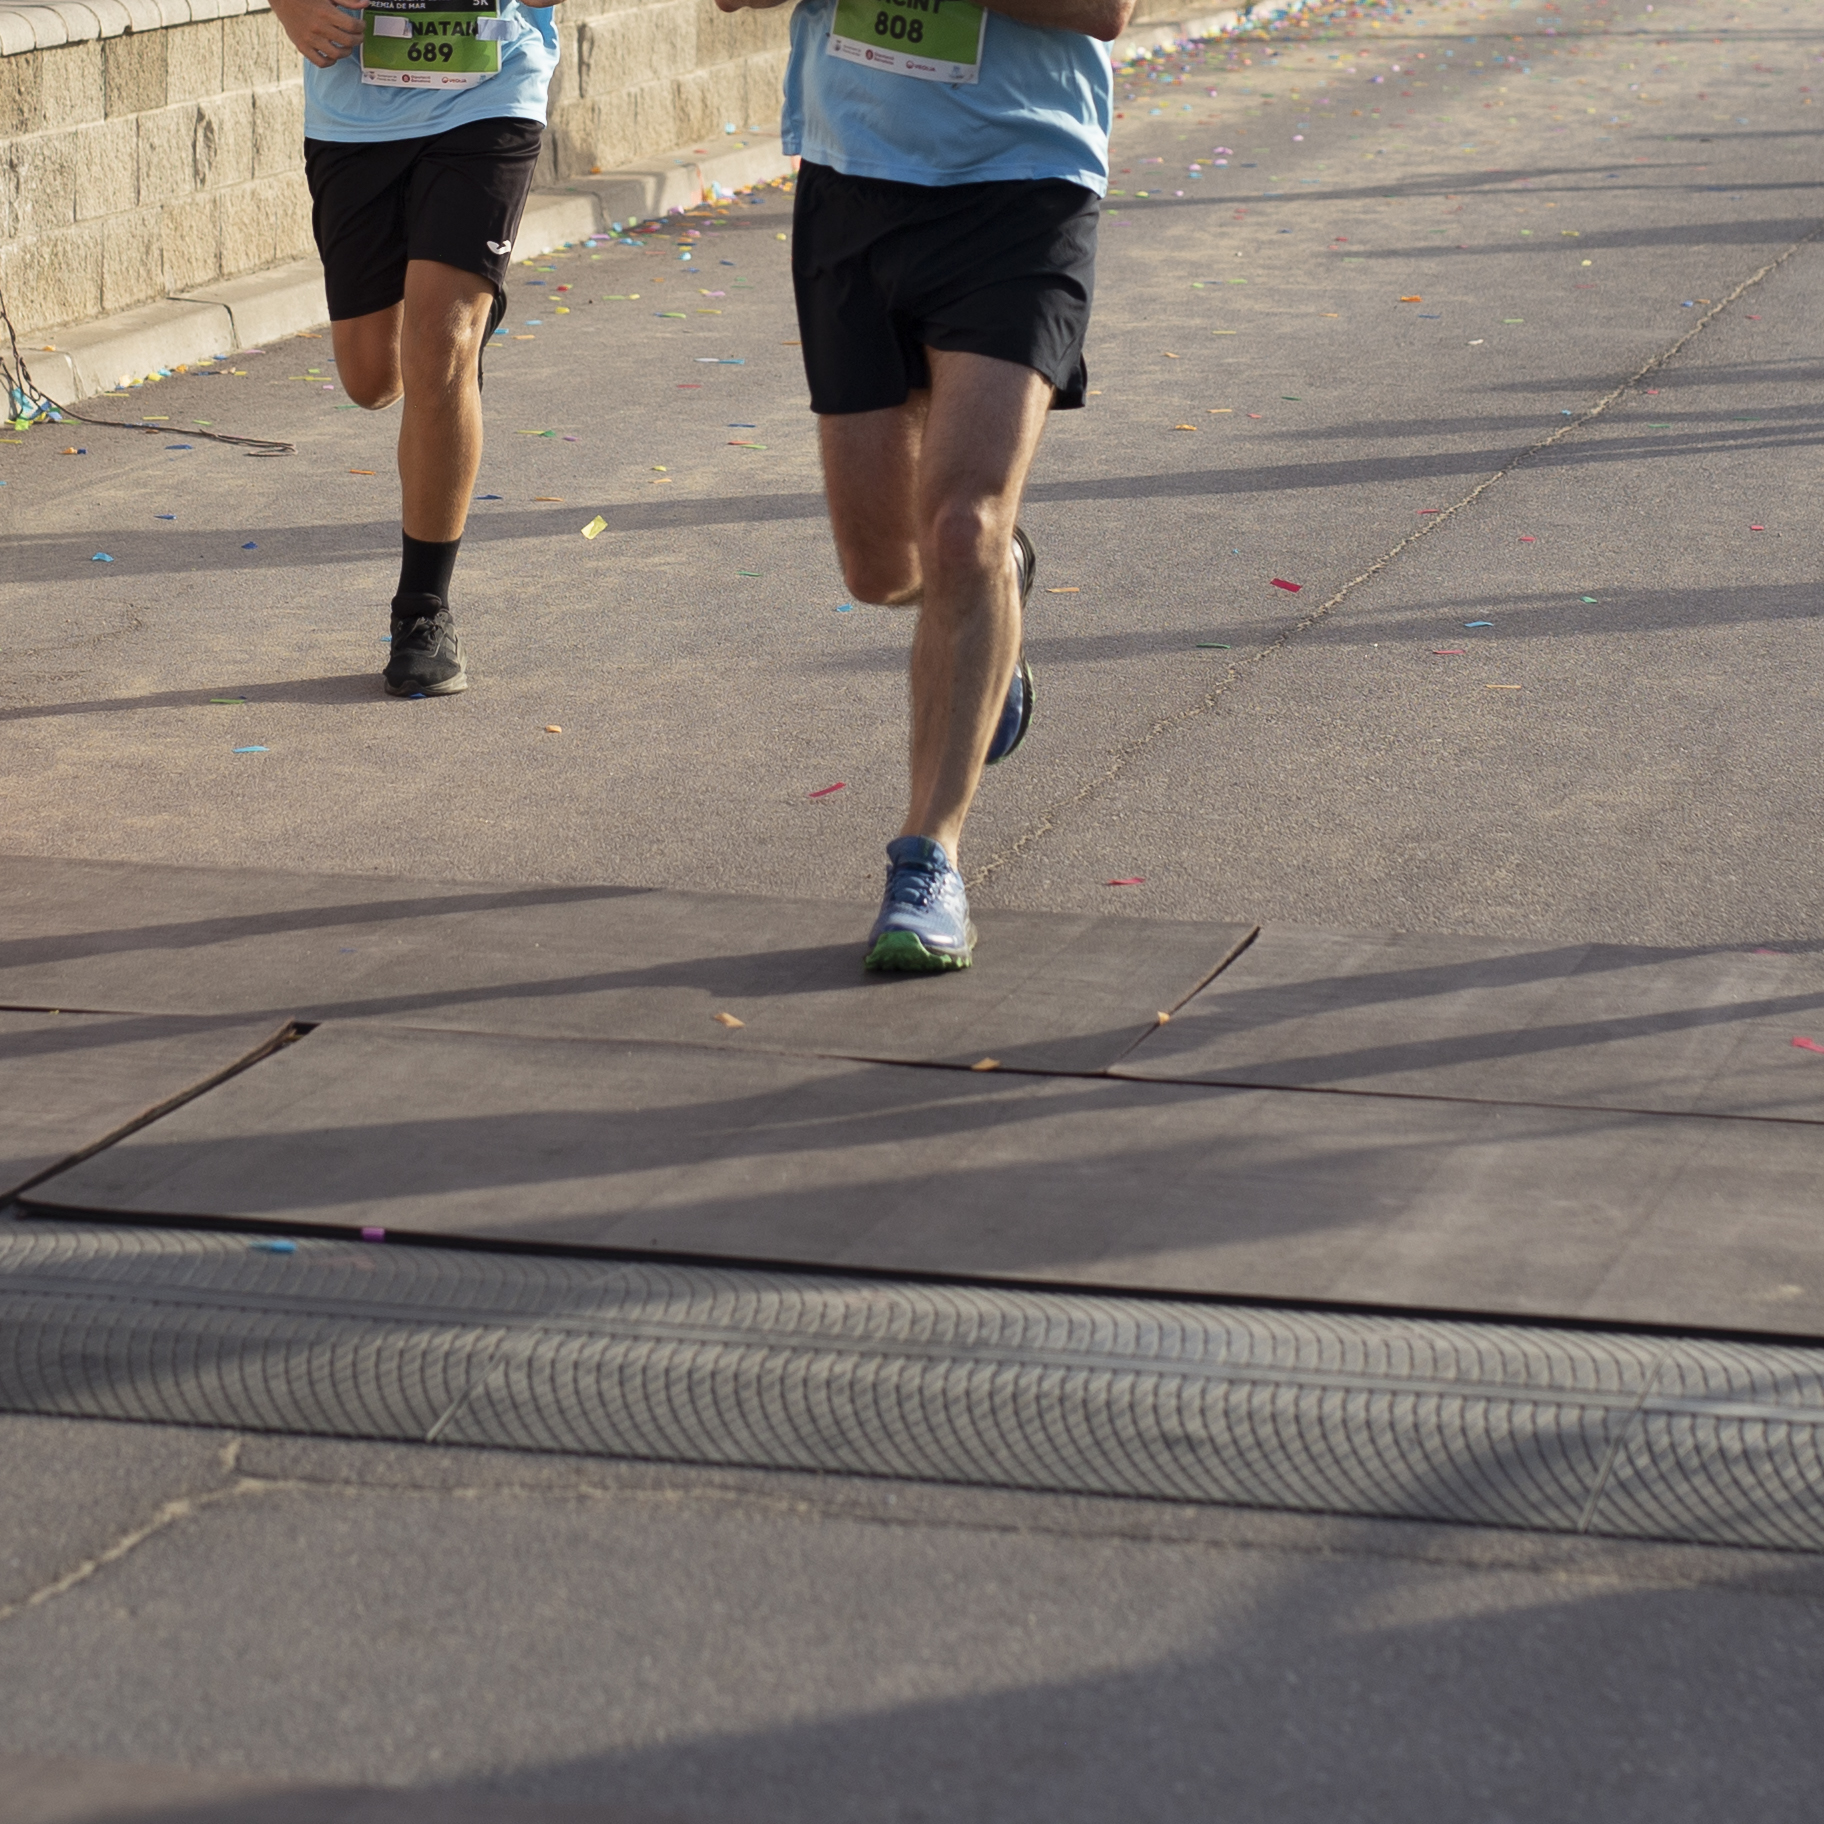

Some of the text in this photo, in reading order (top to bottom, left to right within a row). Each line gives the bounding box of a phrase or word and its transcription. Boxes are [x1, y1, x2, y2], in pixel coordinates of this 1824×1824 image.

[369, 0, 394, 9] REMIÀ
[408, 2, 426, 10] MAR
[411, 21, 479, 37] NATAN
[875, 11, 924, 44] 808
[407, 42, 453, 63] 689
